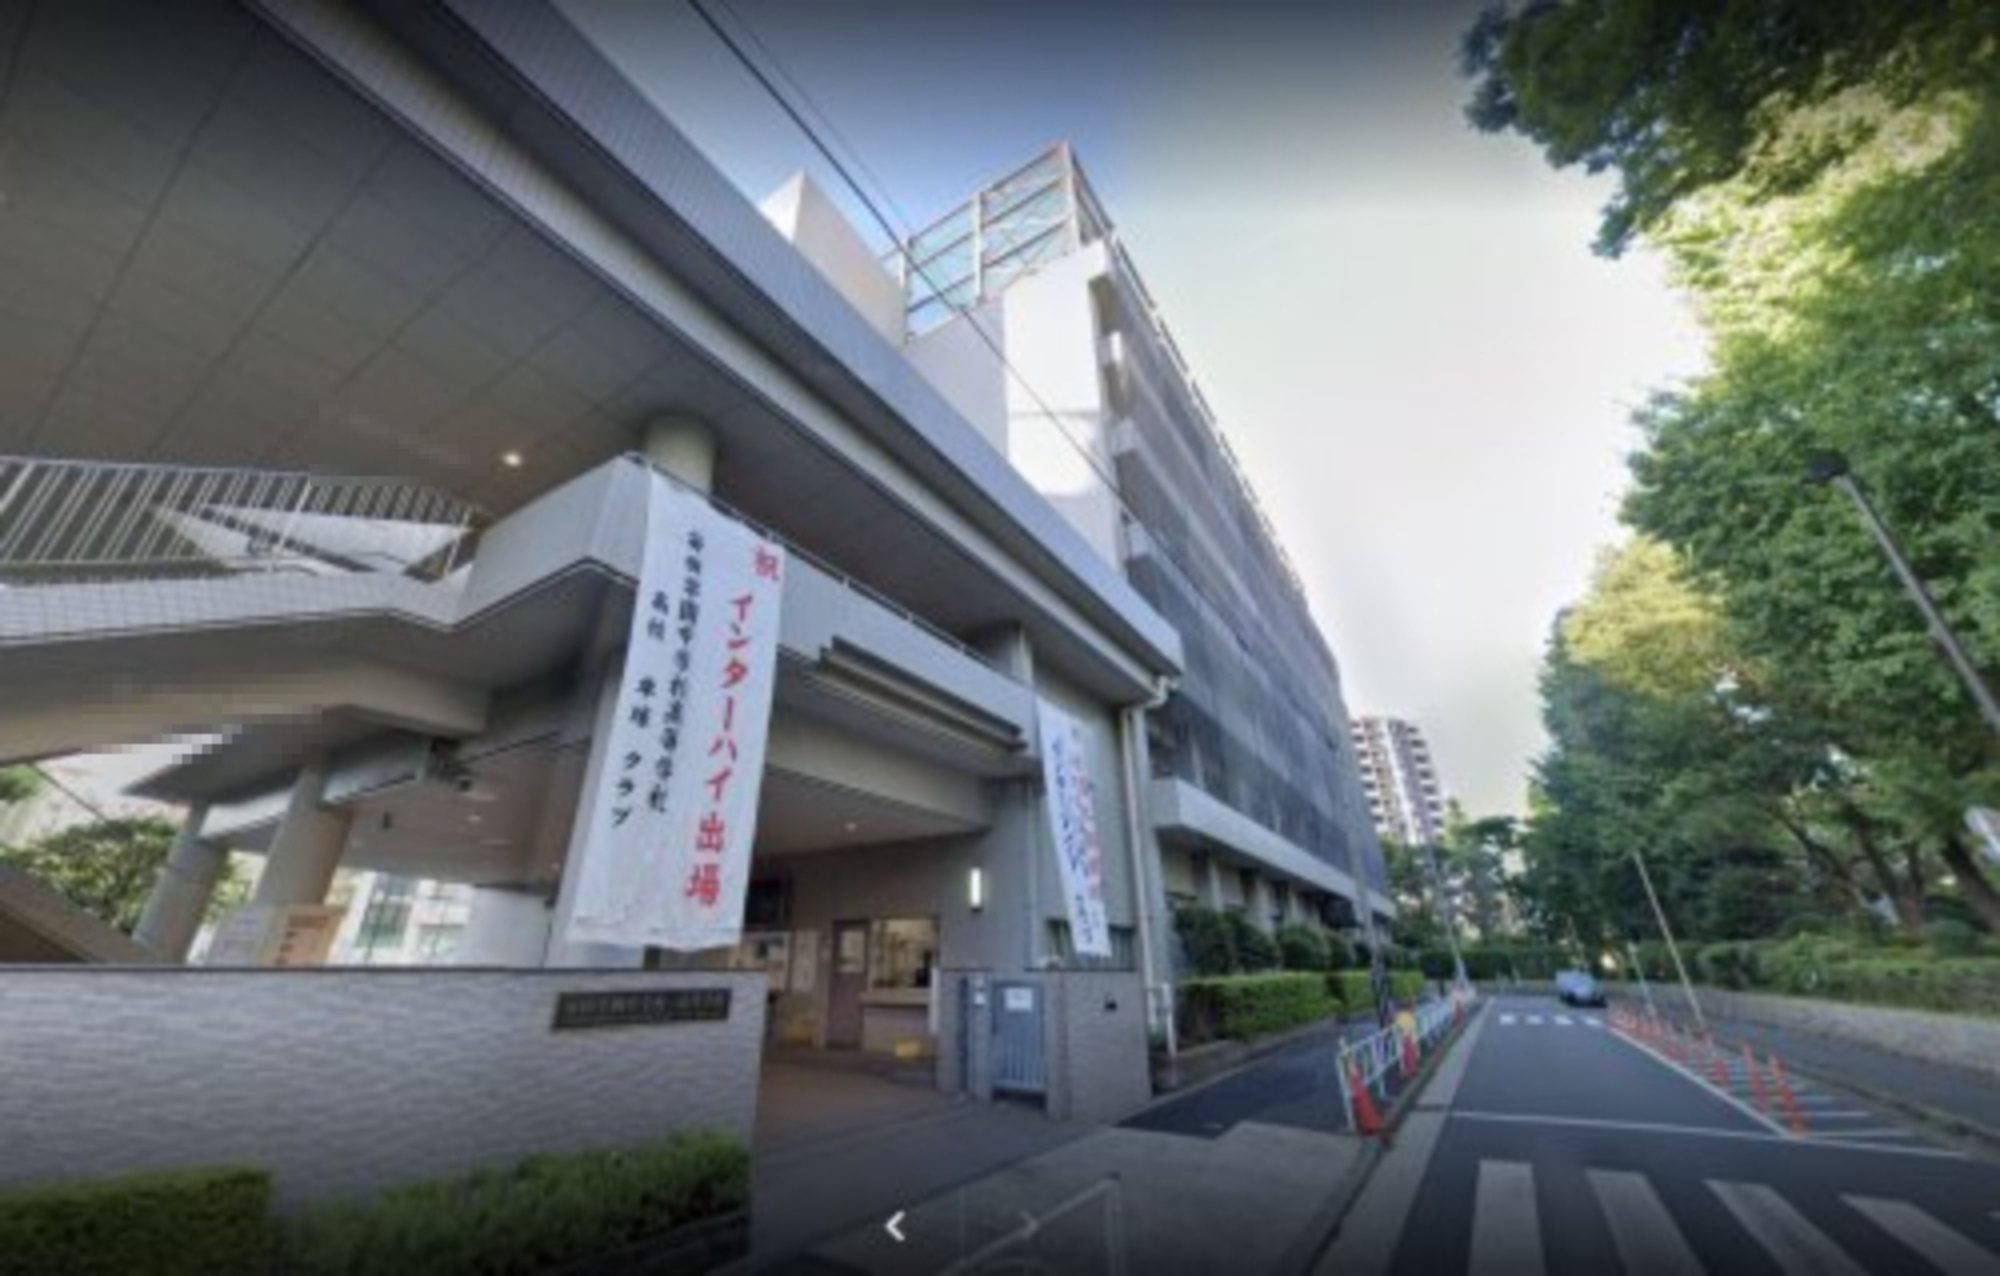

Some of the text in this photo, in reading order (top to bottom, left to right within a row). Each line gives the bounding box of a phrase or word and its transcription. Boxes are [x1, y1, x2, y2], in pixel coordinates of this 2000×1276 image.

[754, 547, 780, 582] 祝
[684, 594, 754, 908] インターハイ出場
